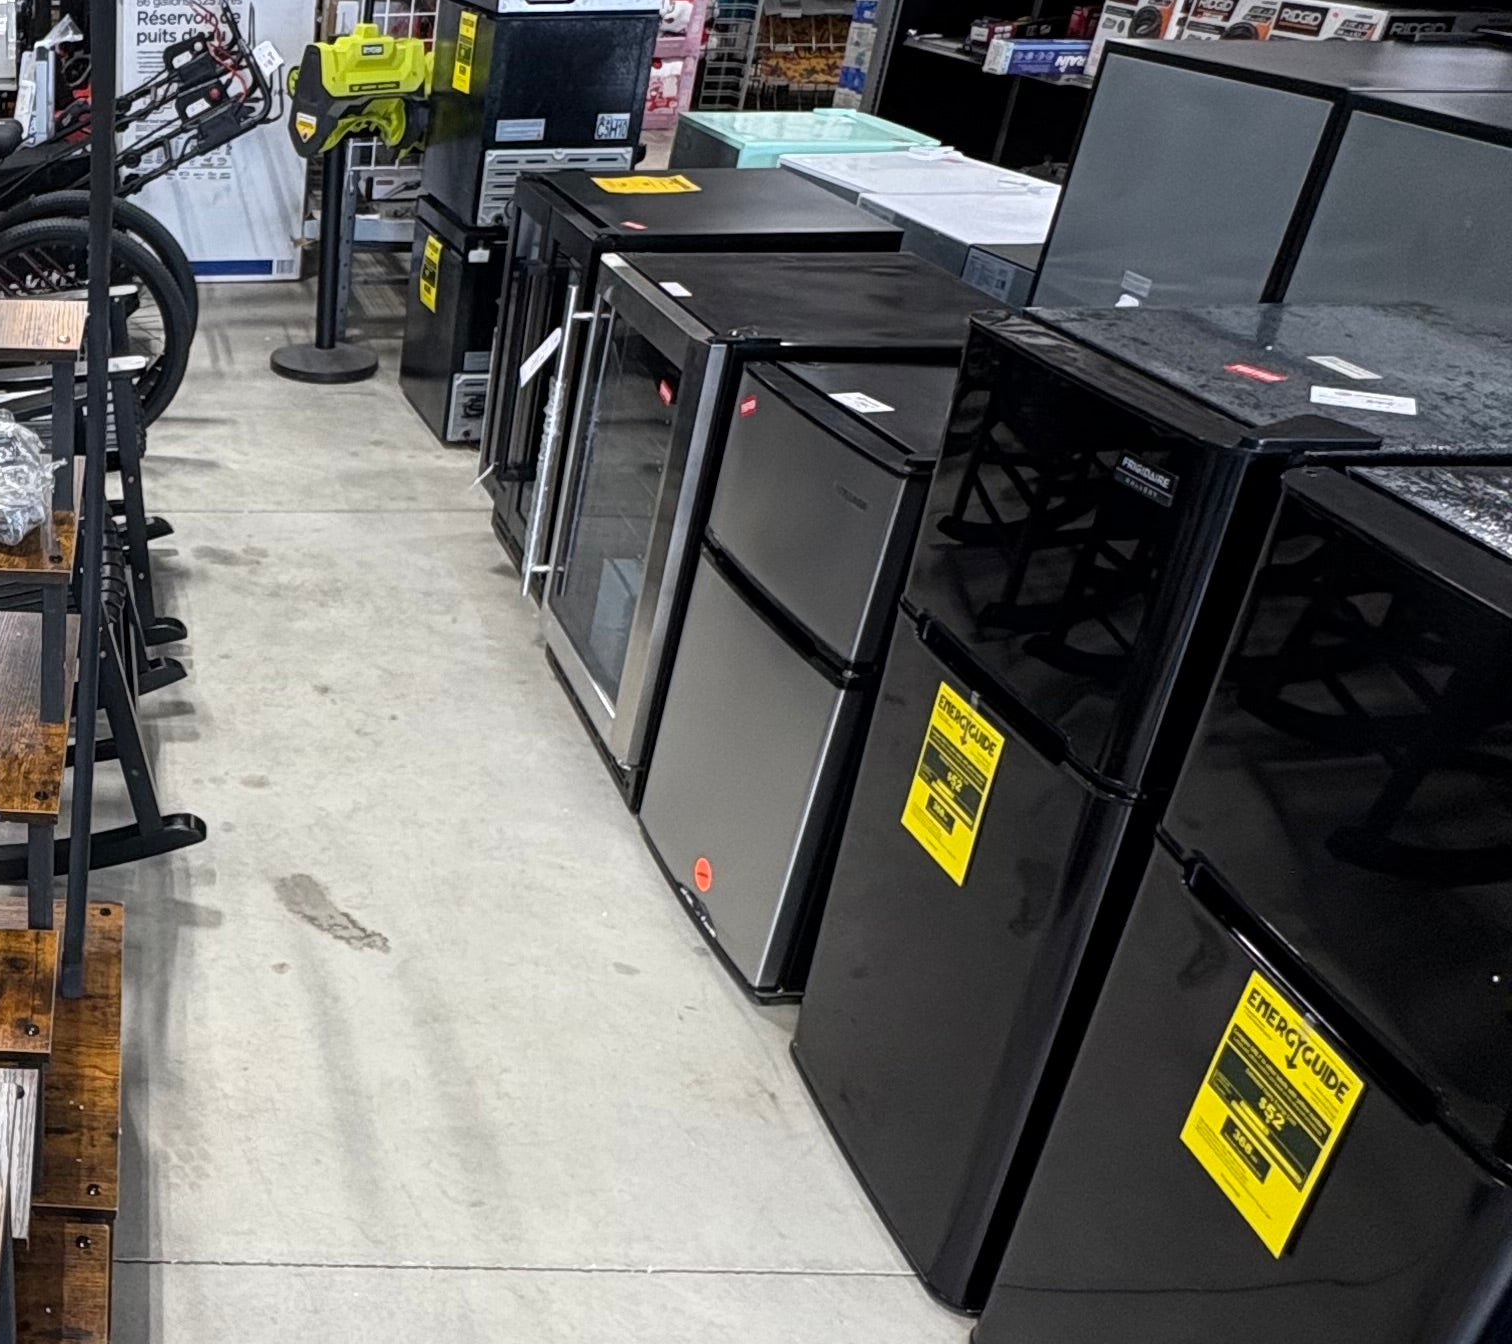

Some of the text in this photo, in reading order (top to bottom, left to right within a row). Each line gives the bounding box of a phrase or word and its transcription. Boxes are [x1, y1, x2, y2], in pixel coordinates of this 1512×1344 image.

[1280, 9, 1322, 25] RIDGID
[137, 28, 178, 47] puits
[1122, 456, 1170, 489] FRIGIDAIRE
[937, 693, 998, 759] ENERGYGUIDE
[1245, 987, 1351, 1105] ENERGYGUIDE
[1258, 1097, 1286, 1131] $52
